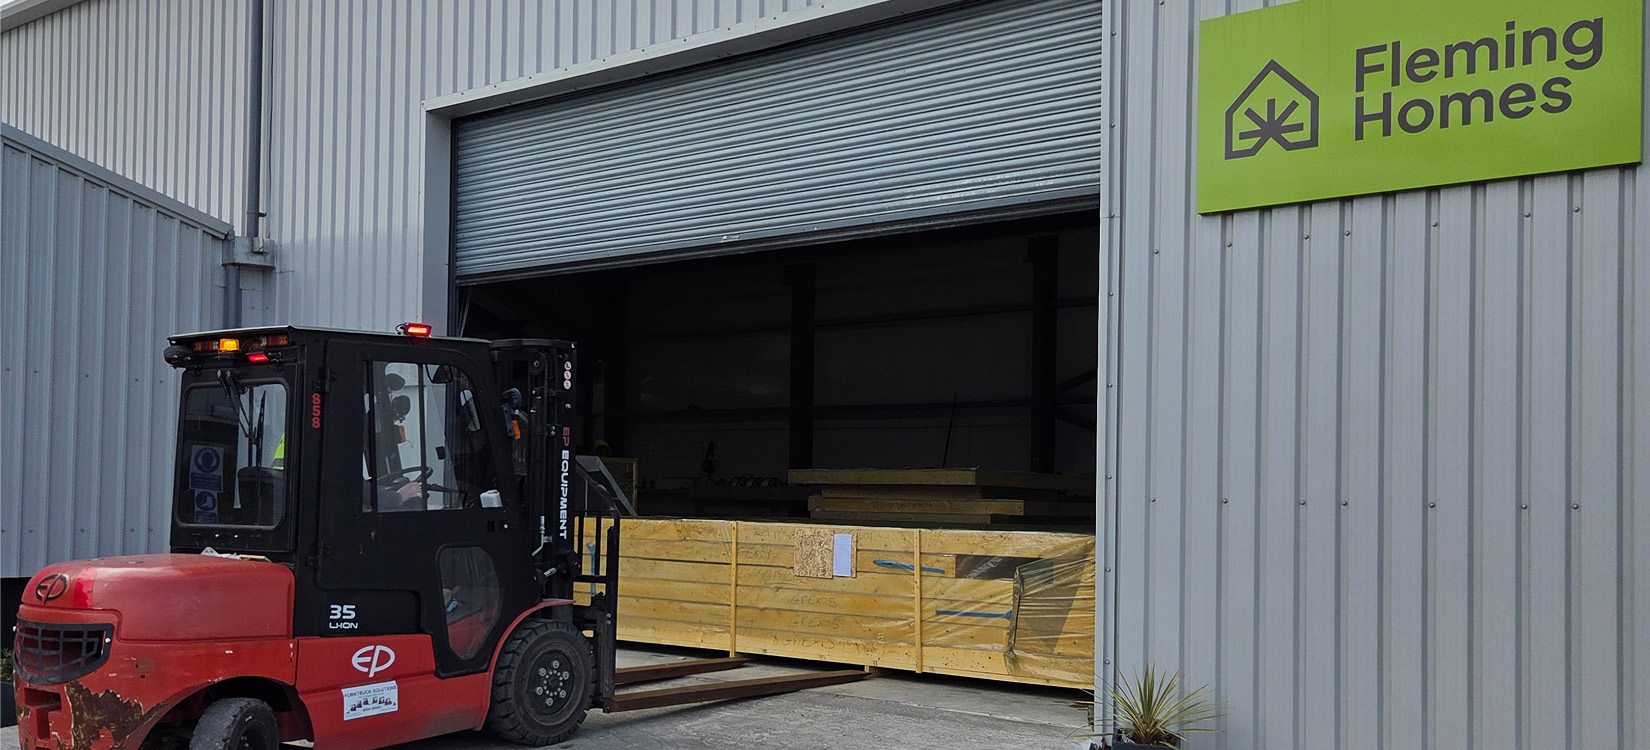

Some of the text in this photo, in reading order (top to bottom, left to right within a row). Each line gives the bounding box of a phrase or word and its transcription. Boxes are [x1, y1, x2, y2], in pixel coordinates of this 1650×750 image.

[1355, 17, 1604, 93] Fleming
[1354, 75, 1573, 141] Homes
[312, 392, 321, 429] 858
[559, 426, 570, 540] EP EQUIPMENT
[328, 604, 356, 619] 35
[351, 645, 396, 678] EP
[373, 685, 397, 693] SOLUTIONS
